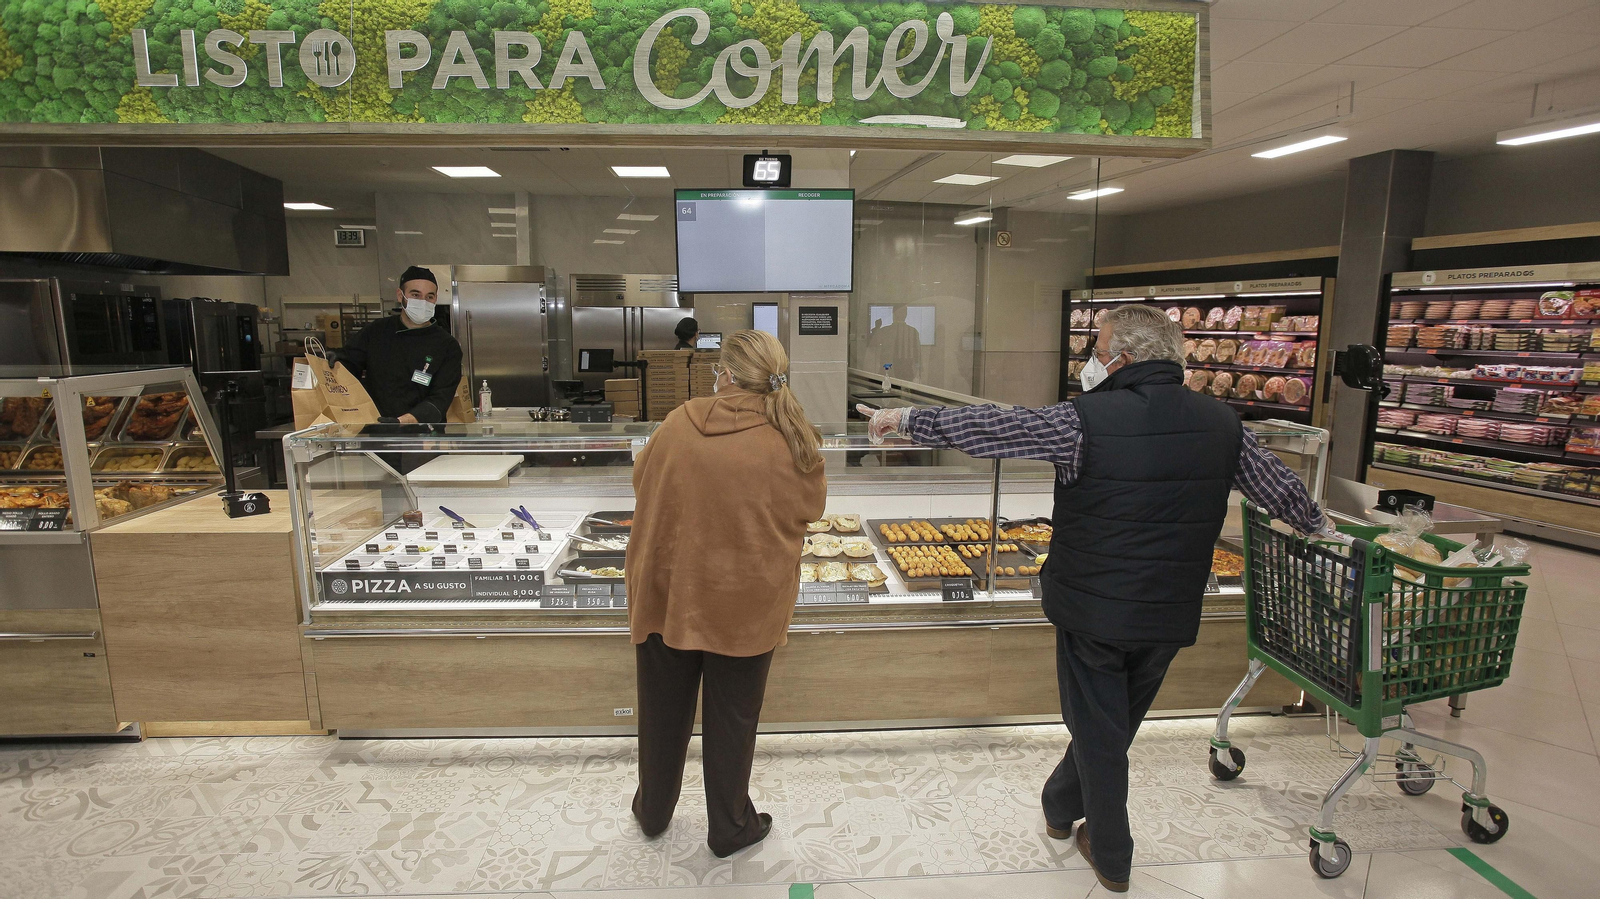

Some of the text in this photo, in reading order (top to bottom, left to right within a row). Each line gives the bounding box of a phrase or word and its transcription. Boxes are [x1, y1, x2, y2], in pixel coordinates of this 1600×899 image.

[132, 8, 993, 110] LISTO PARA Comer
[754, 161, 779, 180] 65
[681, 207, 692, 215] 64
[1478, 270, 1535, 279] PREPARADOS
[351, 579, 466, 594] PIZZA A SU GUSTO
[513, 589, 541, 598] 8,00€
